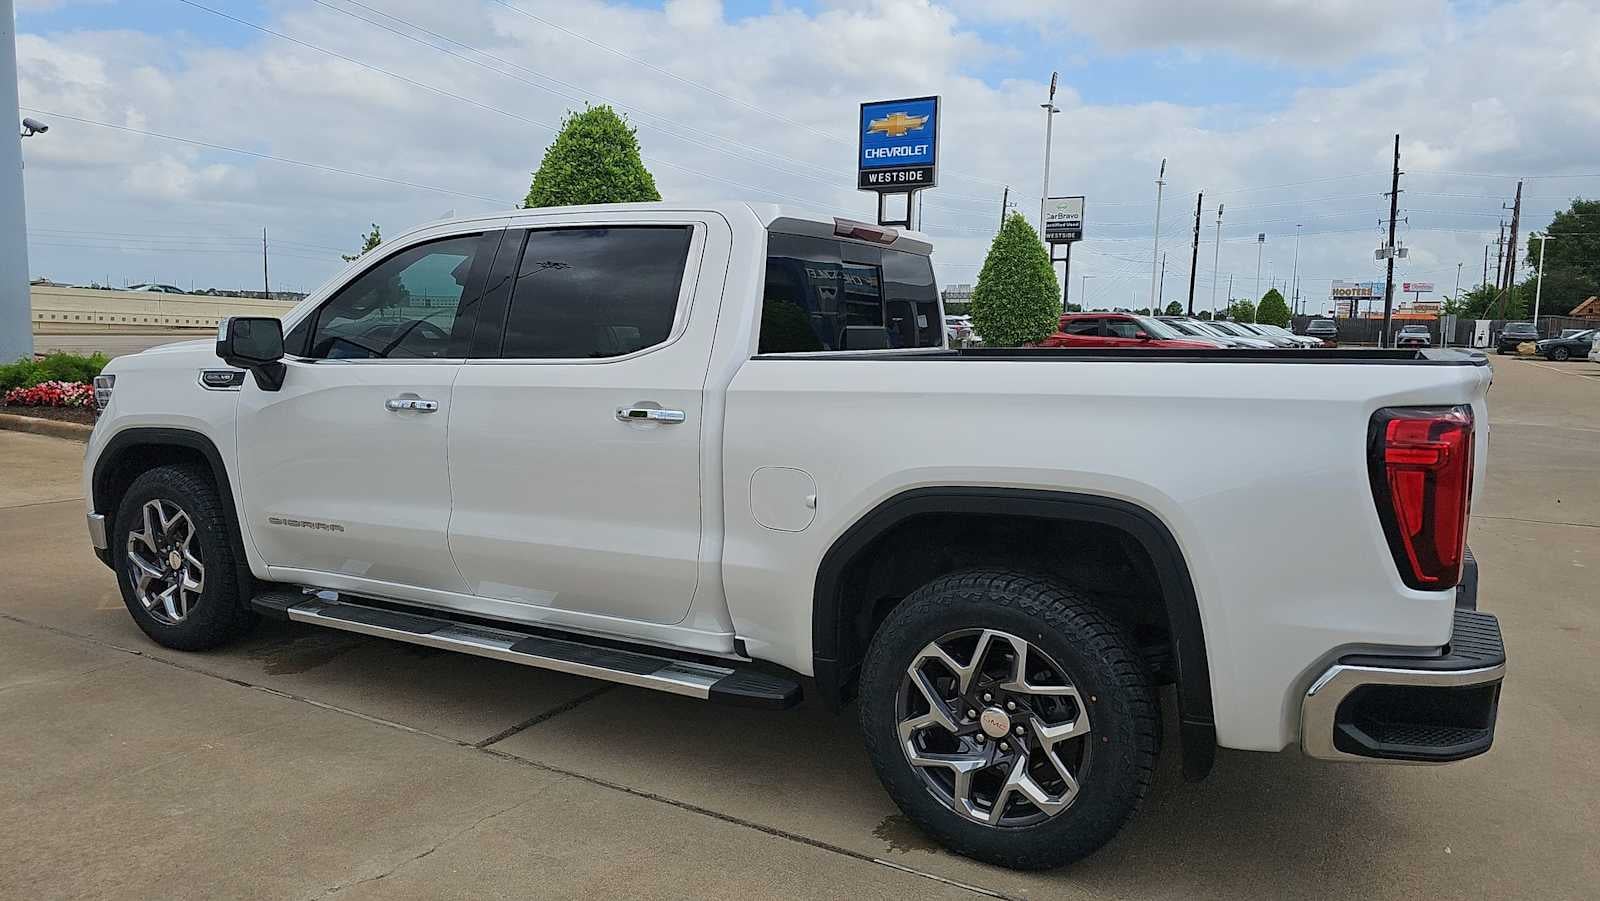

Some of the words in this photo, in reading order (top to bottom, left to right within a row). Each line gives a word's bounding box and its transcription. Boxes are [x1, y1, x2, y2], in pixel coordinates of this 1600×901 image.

[865, 144, 929, 159] CHEVROLET
[868, 170, 924, 183] WESTSIDE
[1332, 288, 1372, 297] HOOTERS
[268, 517, 345, 533] SIERRA
